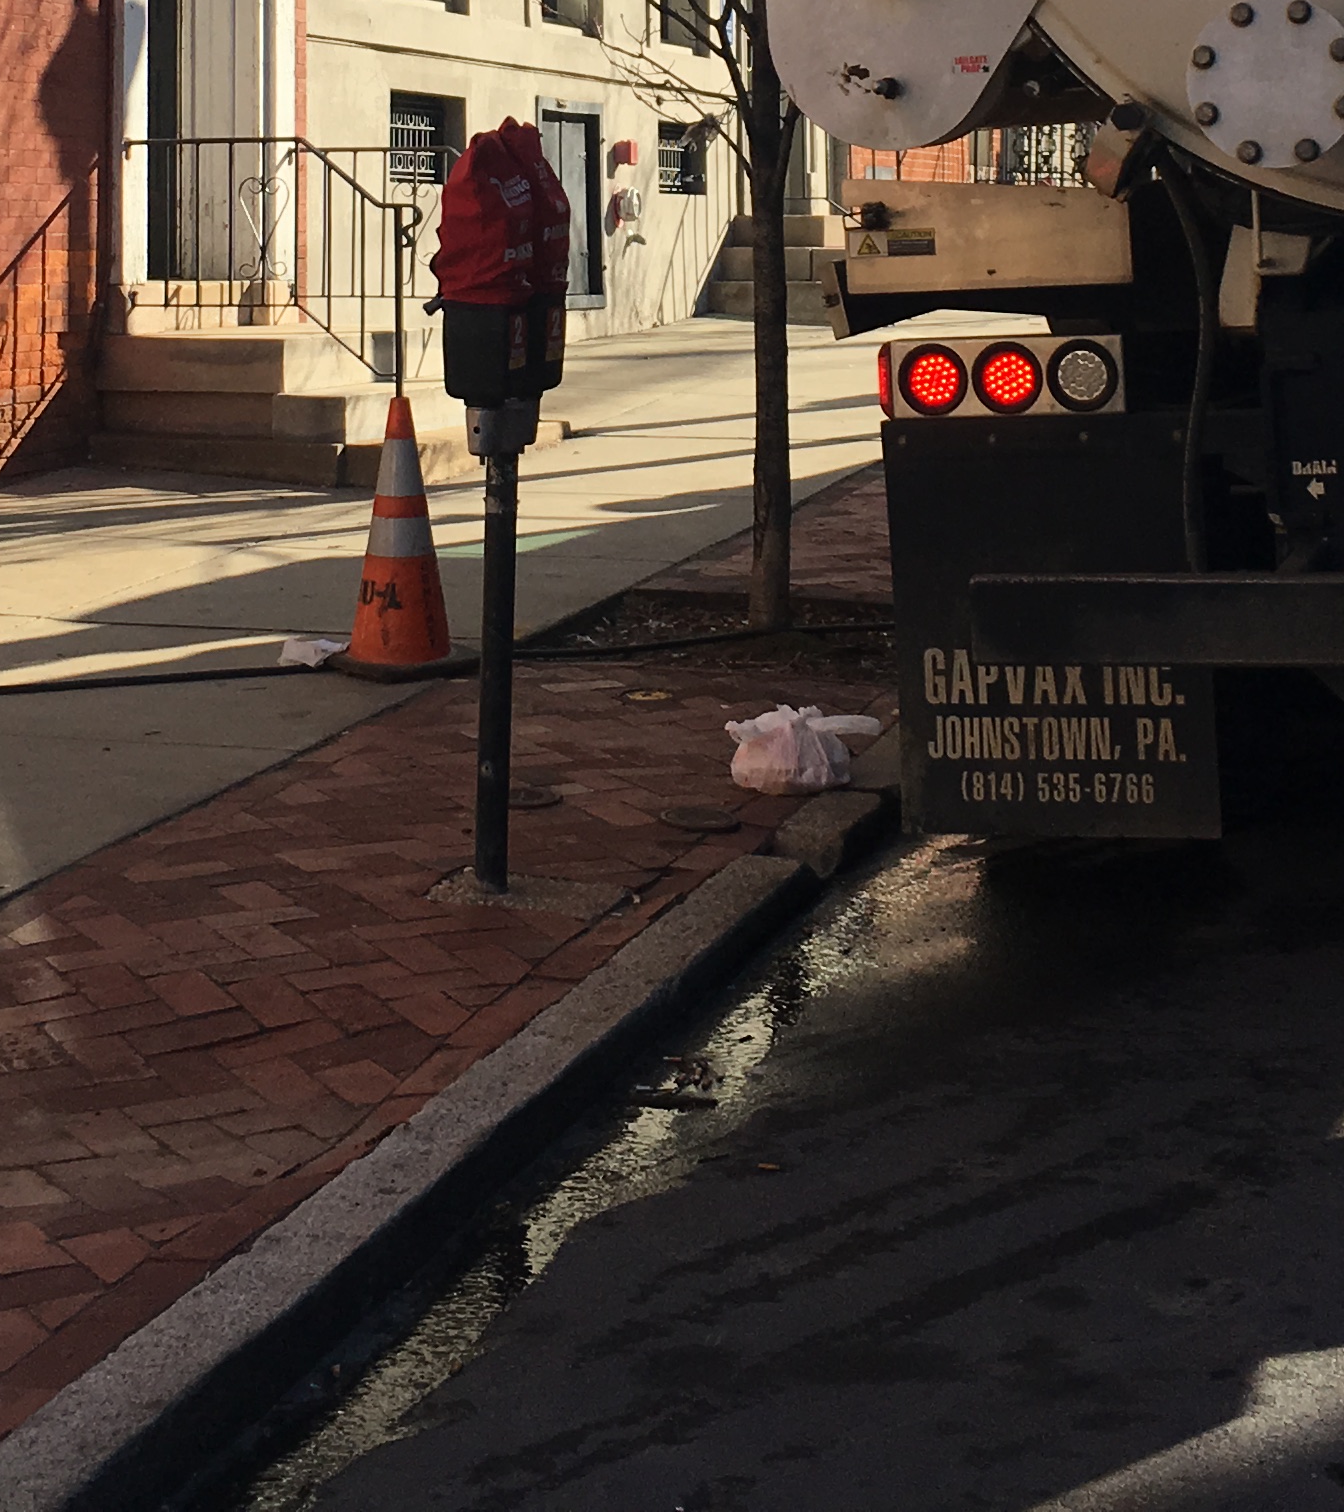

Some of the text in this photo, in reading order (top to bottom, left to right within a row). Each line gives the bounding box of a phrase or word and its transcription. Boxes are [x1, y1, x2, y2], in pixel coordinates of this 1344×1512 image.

[515, 315, 523, 344] 2
[551, 310, 561, 337] 2
[922, 647, 1186, 707] GAPVAX INC.
[927, 715, 1187, 762] JOHNSTOWN, PA.
[960, 770, 1155, 805] (814) 535-6766
